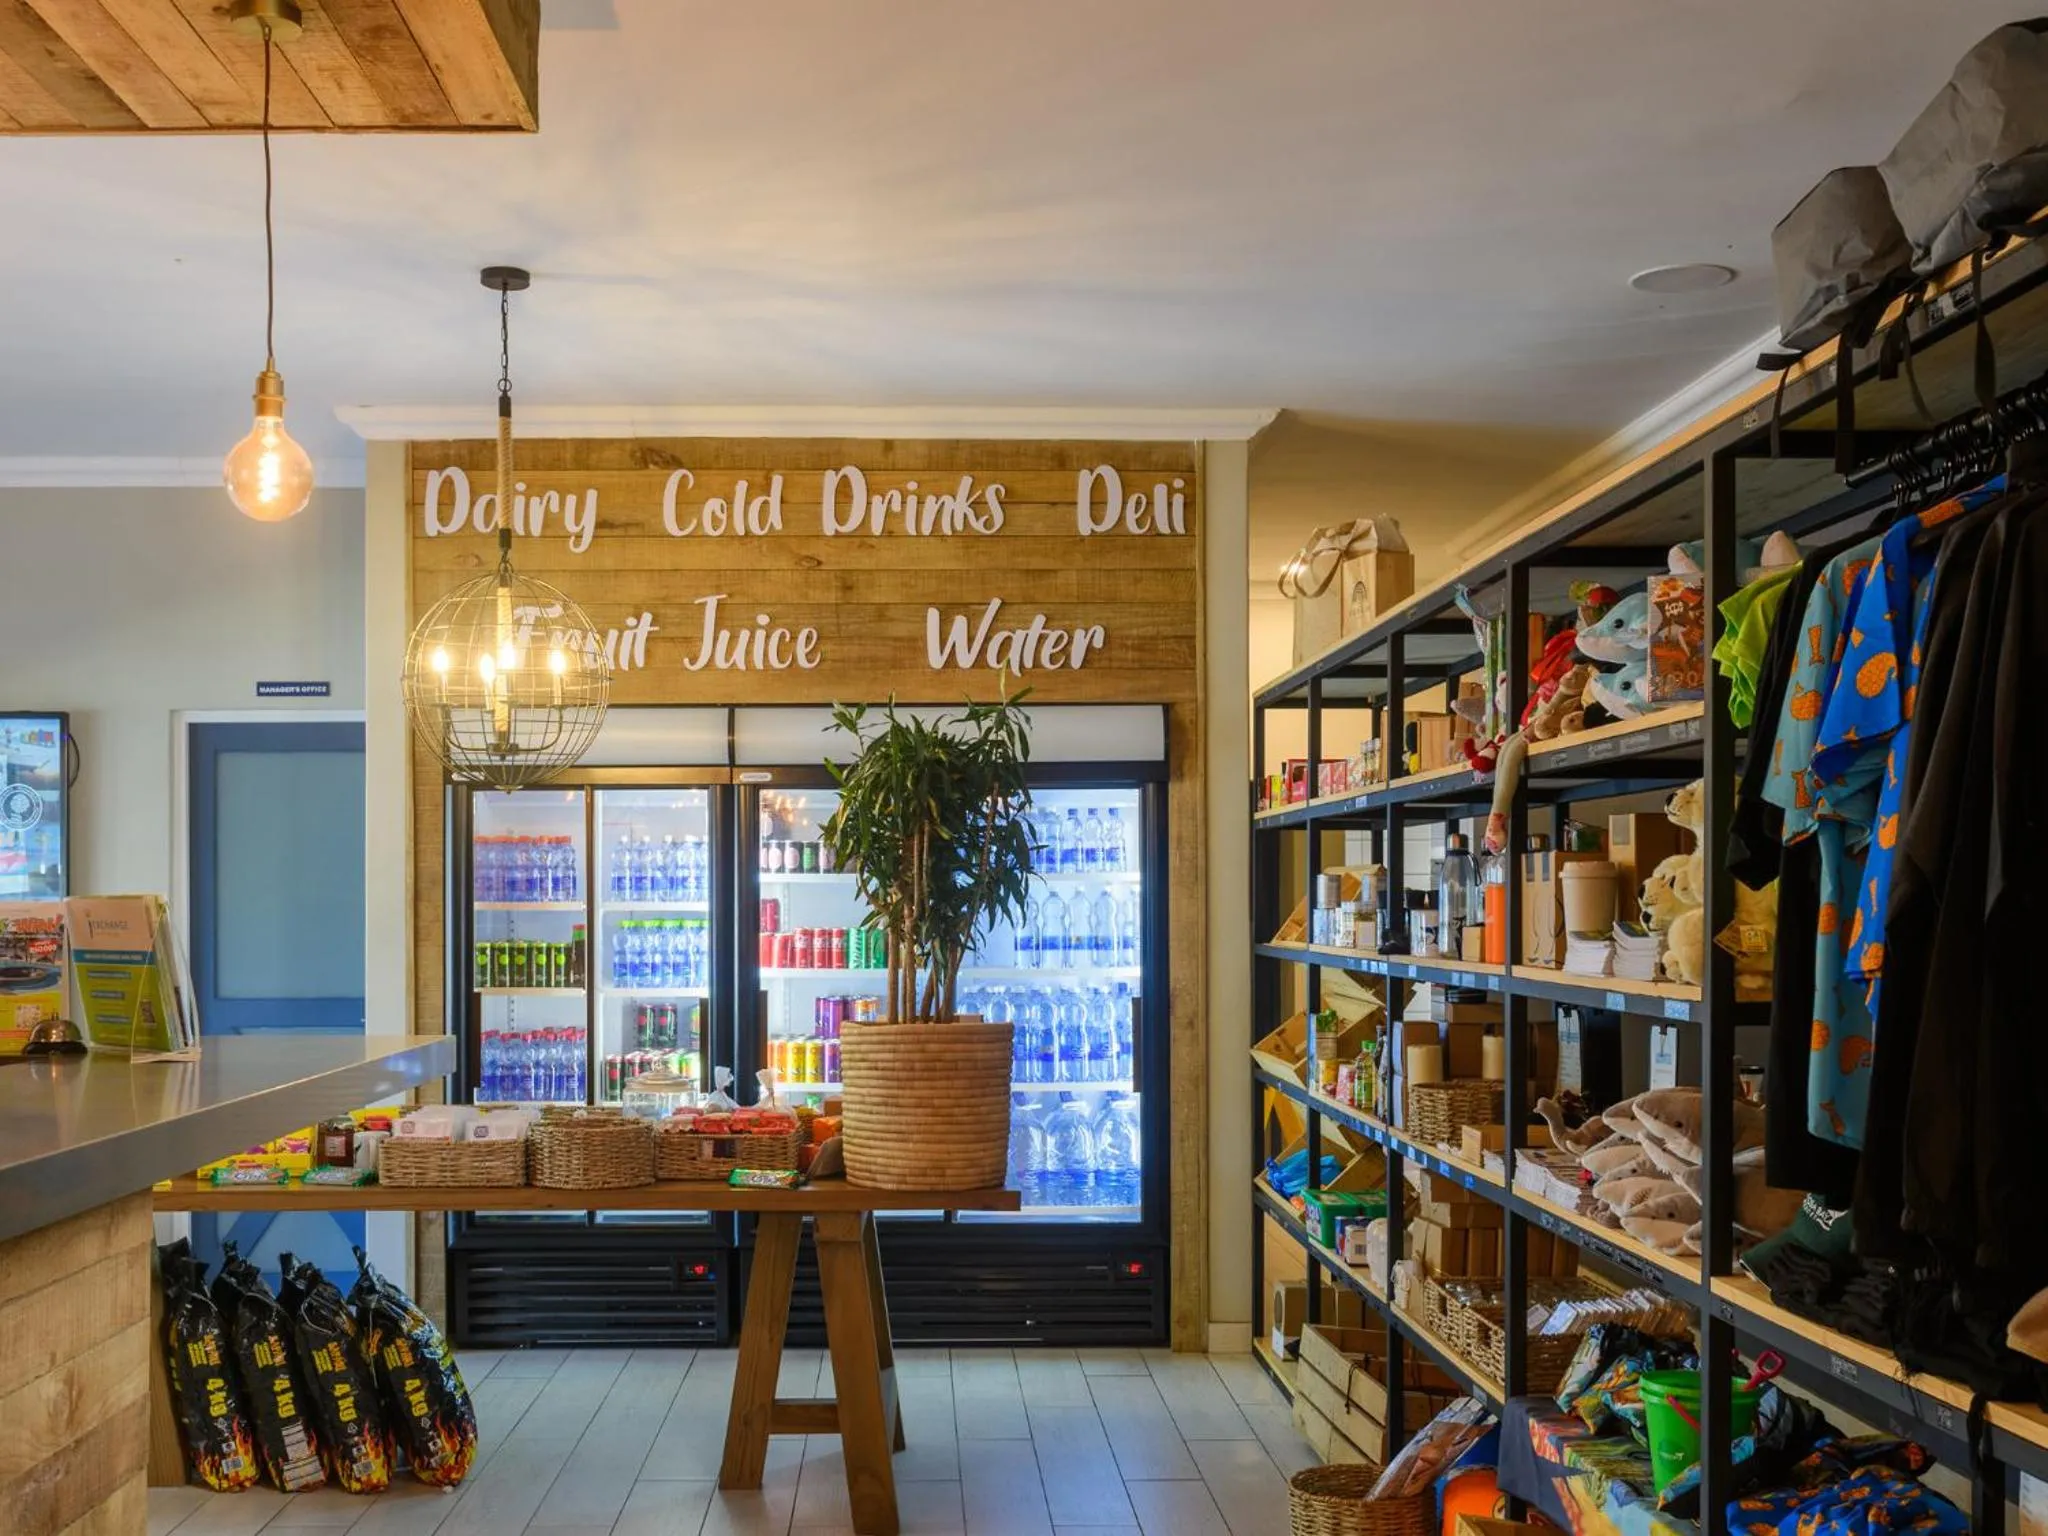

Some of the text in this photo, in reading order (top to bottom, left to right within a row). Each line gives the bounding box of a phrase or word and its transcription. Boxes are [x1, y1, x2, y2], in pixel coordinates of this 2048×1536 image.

[424, 464, 1187, 554] Dairy Cold Drinks Deli
[683, 593, 822, 672] Juice
[926, 597, 1106, 677] Water
